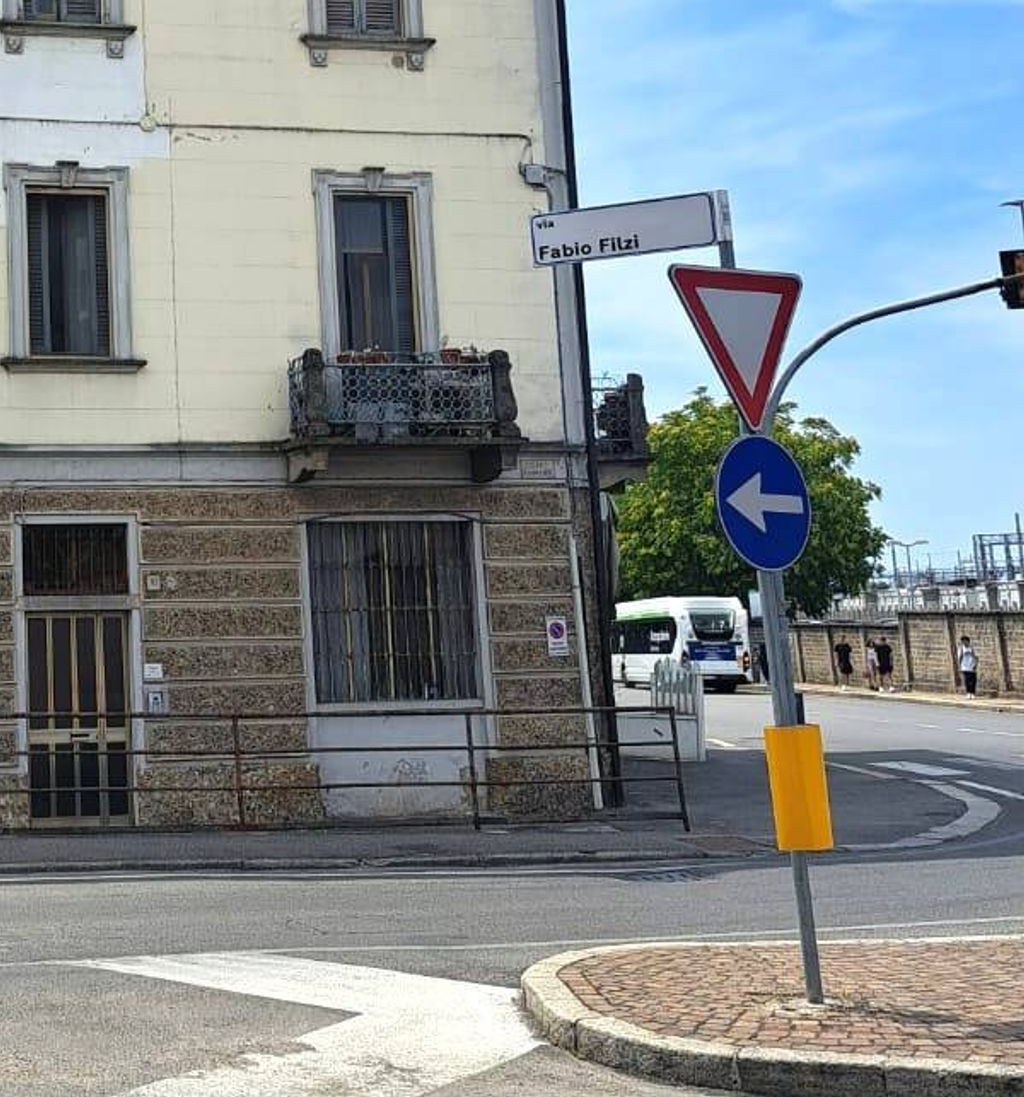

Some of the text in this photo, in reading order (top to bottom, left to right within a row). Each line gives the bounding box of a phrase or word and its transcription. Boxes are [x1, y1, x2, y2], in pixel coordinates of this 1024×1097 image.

[537, 218, 555, 230] via
[539, 234, 640, 261] Fabio Filzi
